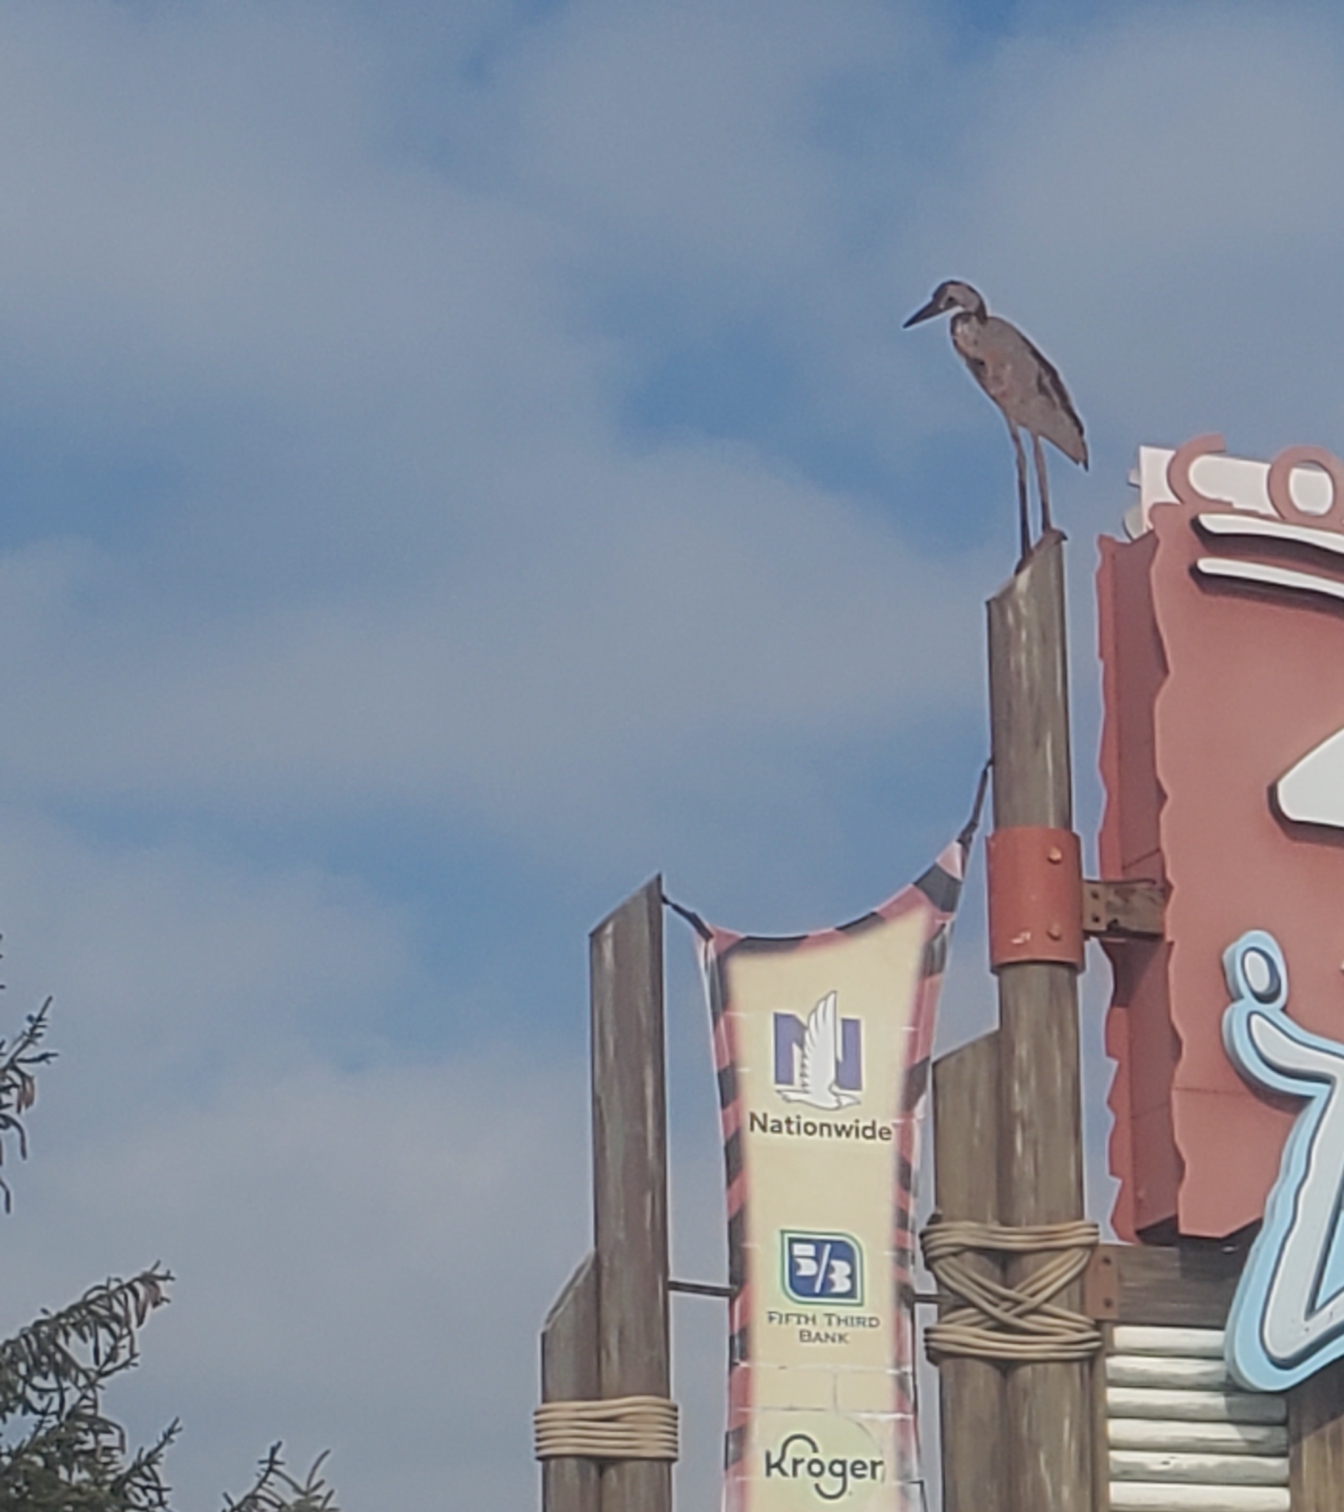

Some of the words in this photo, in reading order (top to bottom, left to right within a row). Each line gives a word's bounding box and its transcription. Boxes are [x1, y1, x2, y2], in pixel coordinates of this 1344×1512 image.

[749, 1112, 894, 1142] Nationwide
[767, 1310, 817, 1326] FIFTH
[823, 1312, 881, 1329] THIRD
[798, 1329, 851, 1344] BANK
[764, 1435, 884, 1500] Kroger
